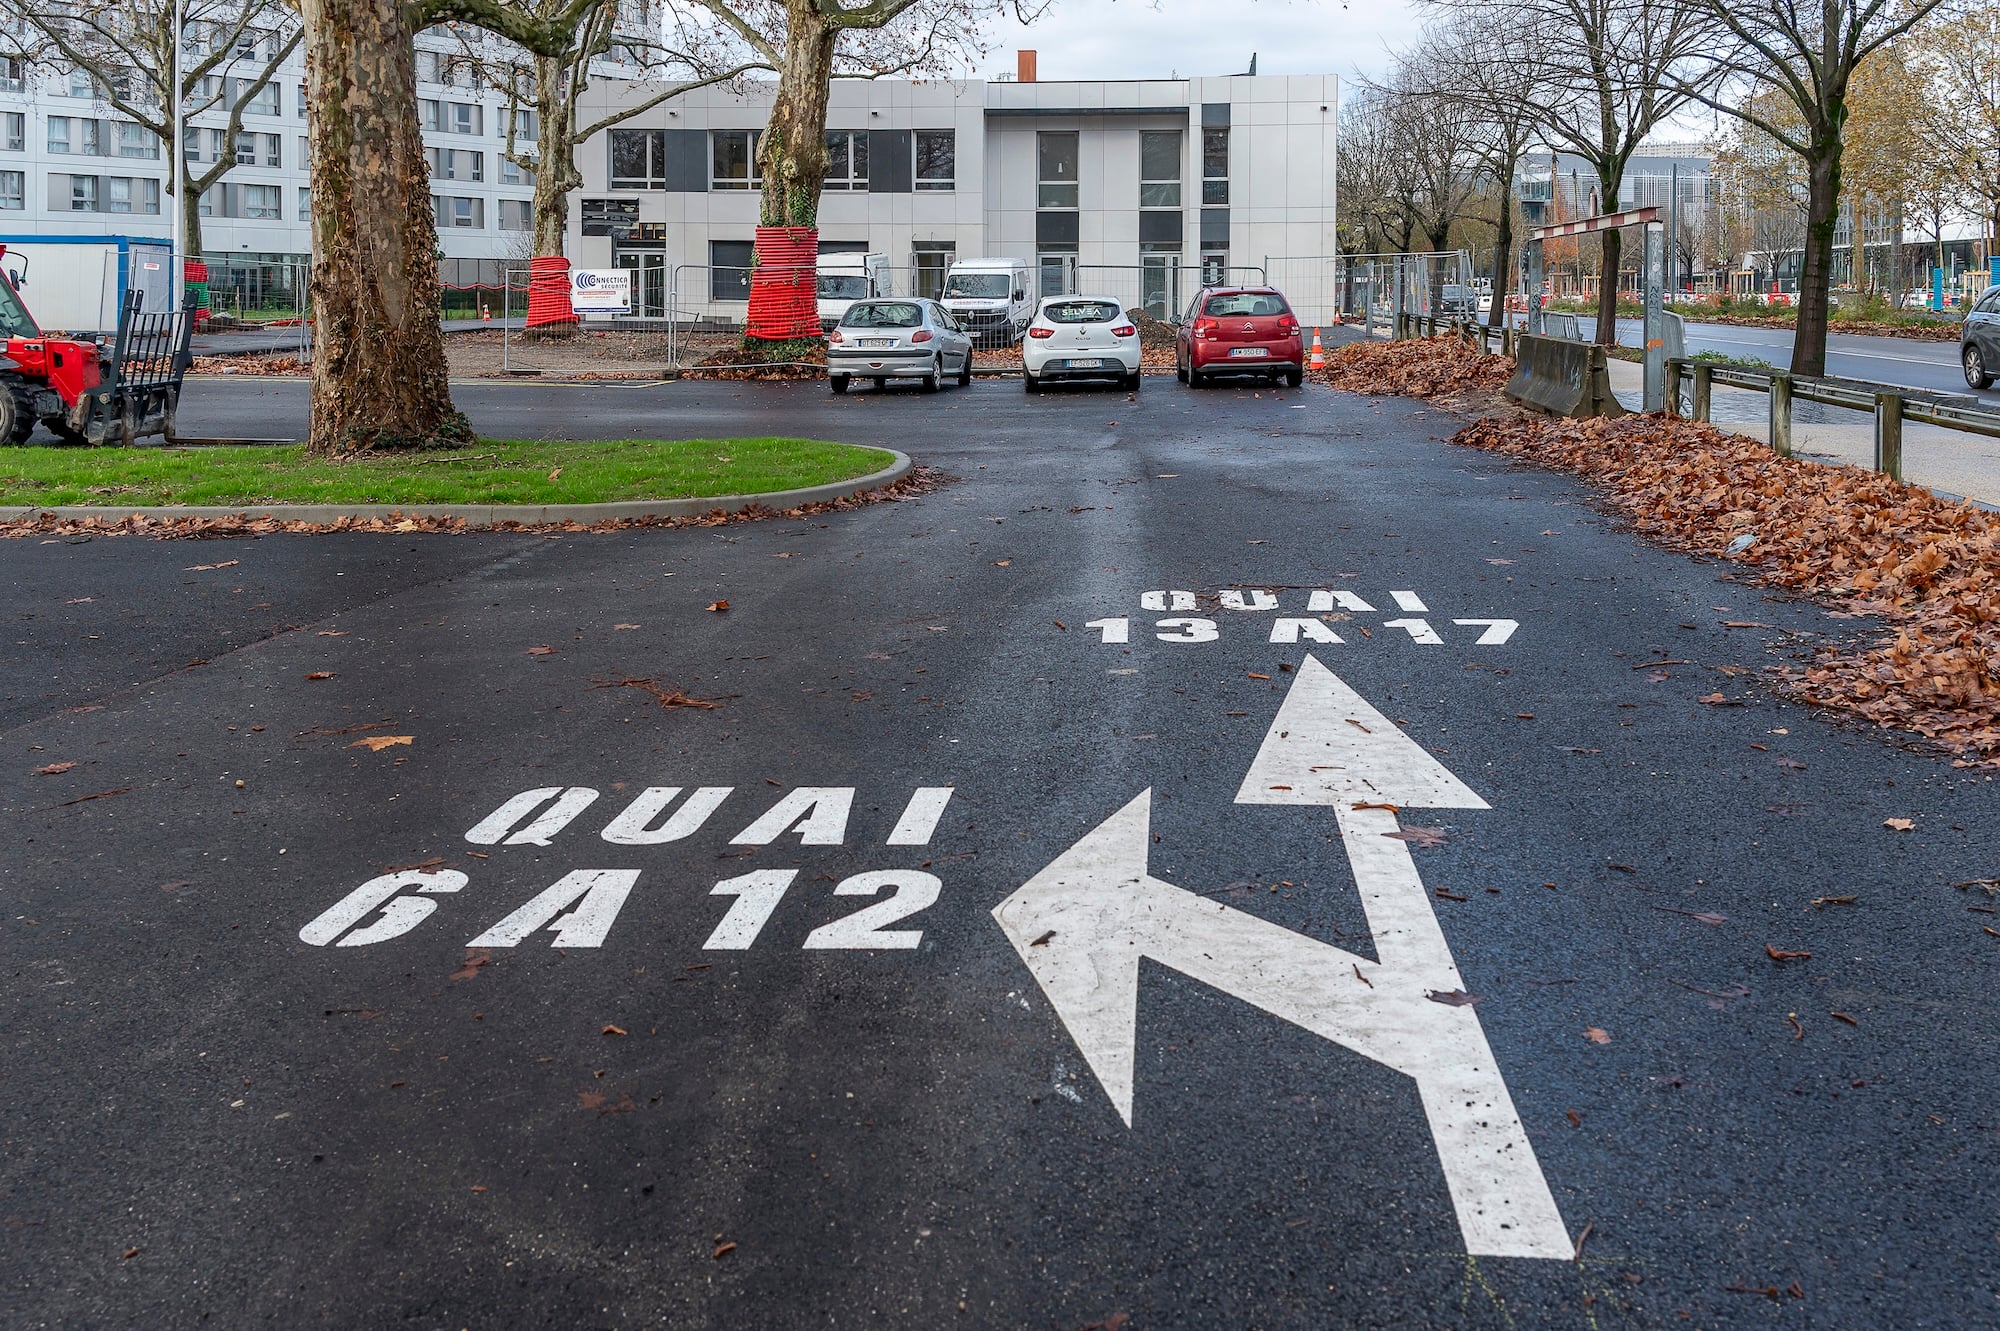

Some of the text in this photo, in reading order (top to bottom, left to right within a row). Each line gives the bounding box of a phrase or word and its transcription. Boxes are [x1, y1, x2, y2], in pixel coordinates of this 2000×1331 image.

[588, 275, 628, 286] CONNECTICA
[1062, 308, 1101, 316] SELVEA
[1141, 590, 1429, 612] QUAI
[1085, 618, 1519, 645] 13 A 17
[465, 787, 955, 846] QUAI
[299, 869, 942, 950] 6 A 12
